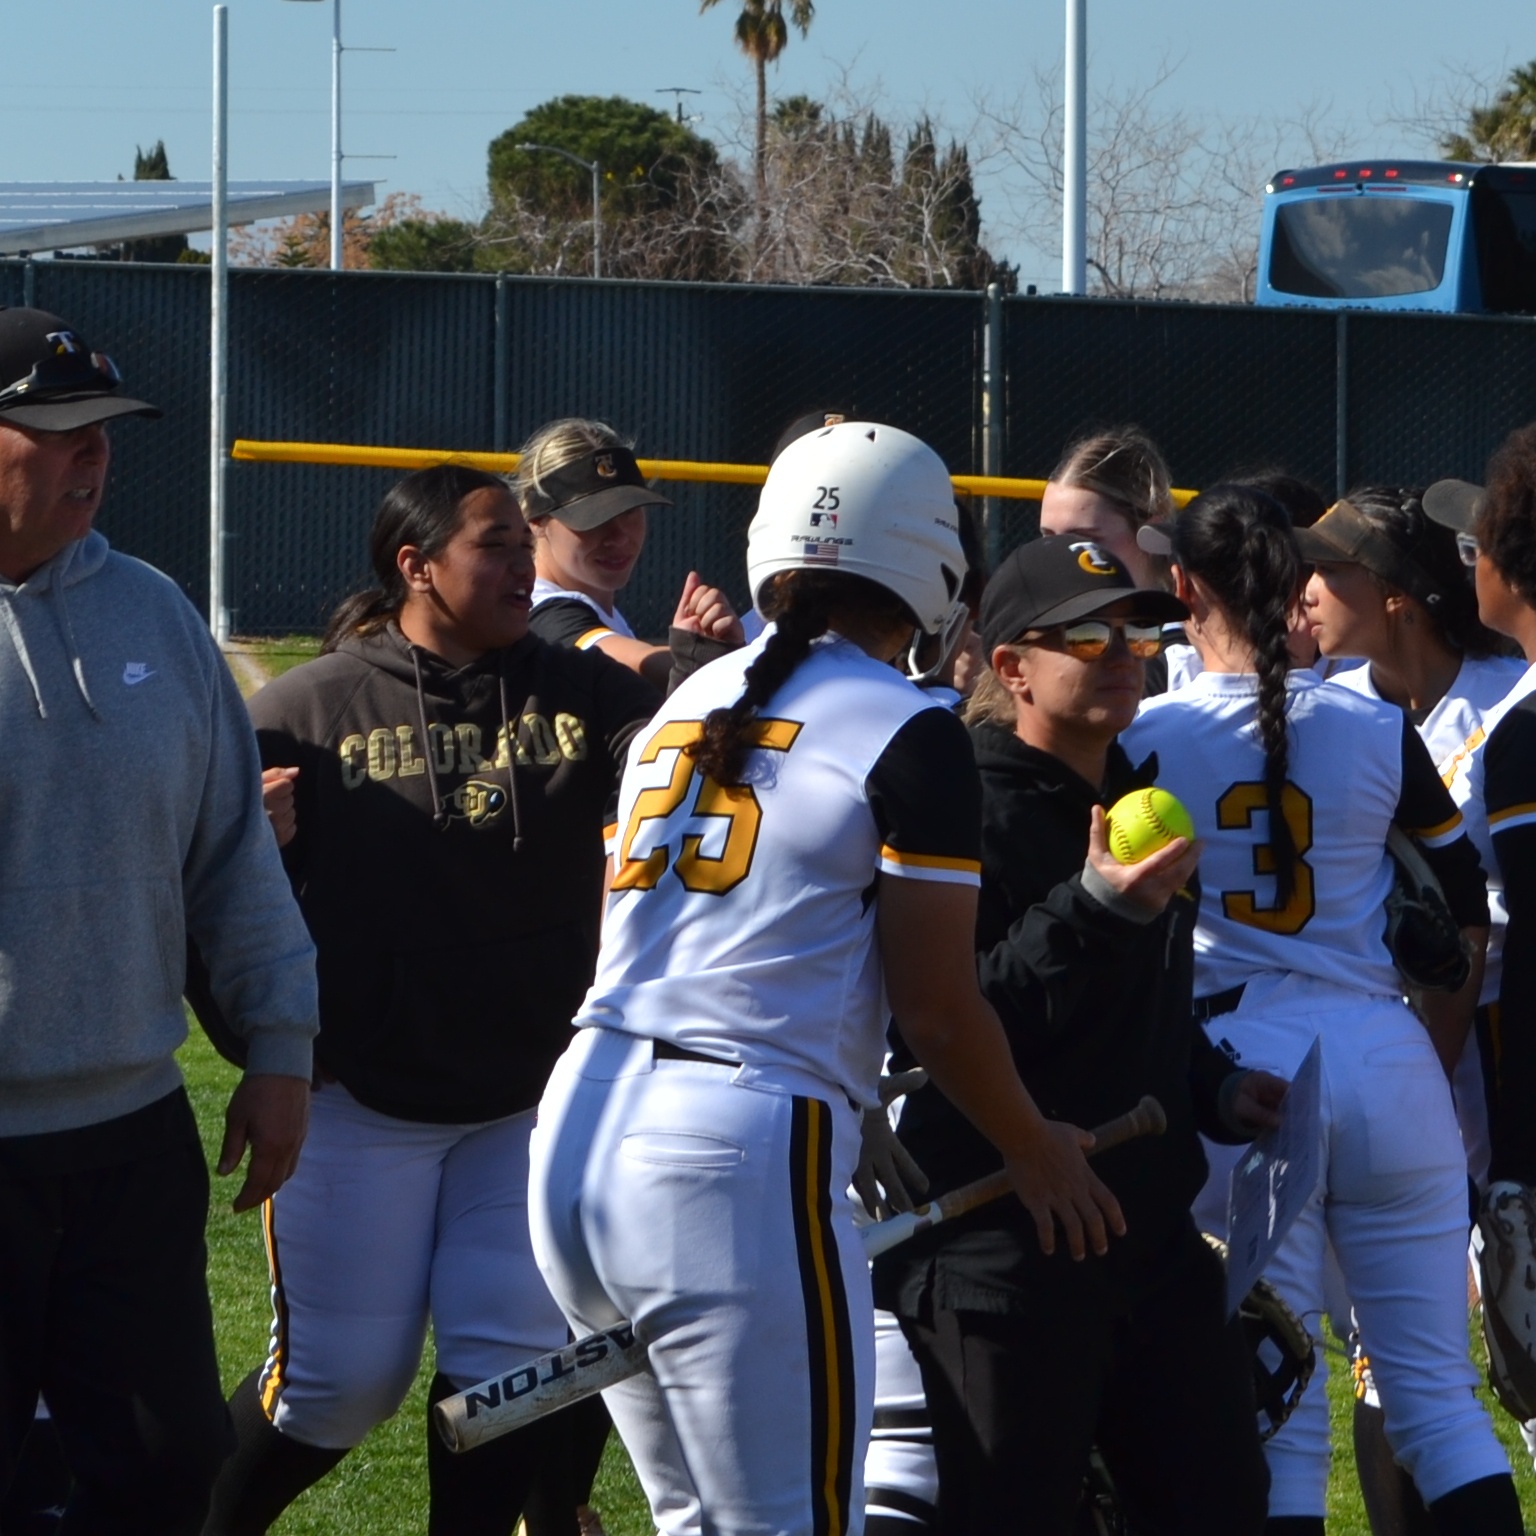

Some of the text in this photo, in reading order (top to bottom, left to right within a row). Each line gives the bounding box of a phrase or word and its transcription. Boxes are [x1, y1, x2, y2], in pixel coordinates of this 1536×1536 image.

[812, 485, 840, 511] 25
[340, 712, 588, 790] COLORADO
[610, 717, 805, 897] 25
[1216, 779, 1316, 935] 3
[465, 1325, 636, 1420] ASTON
